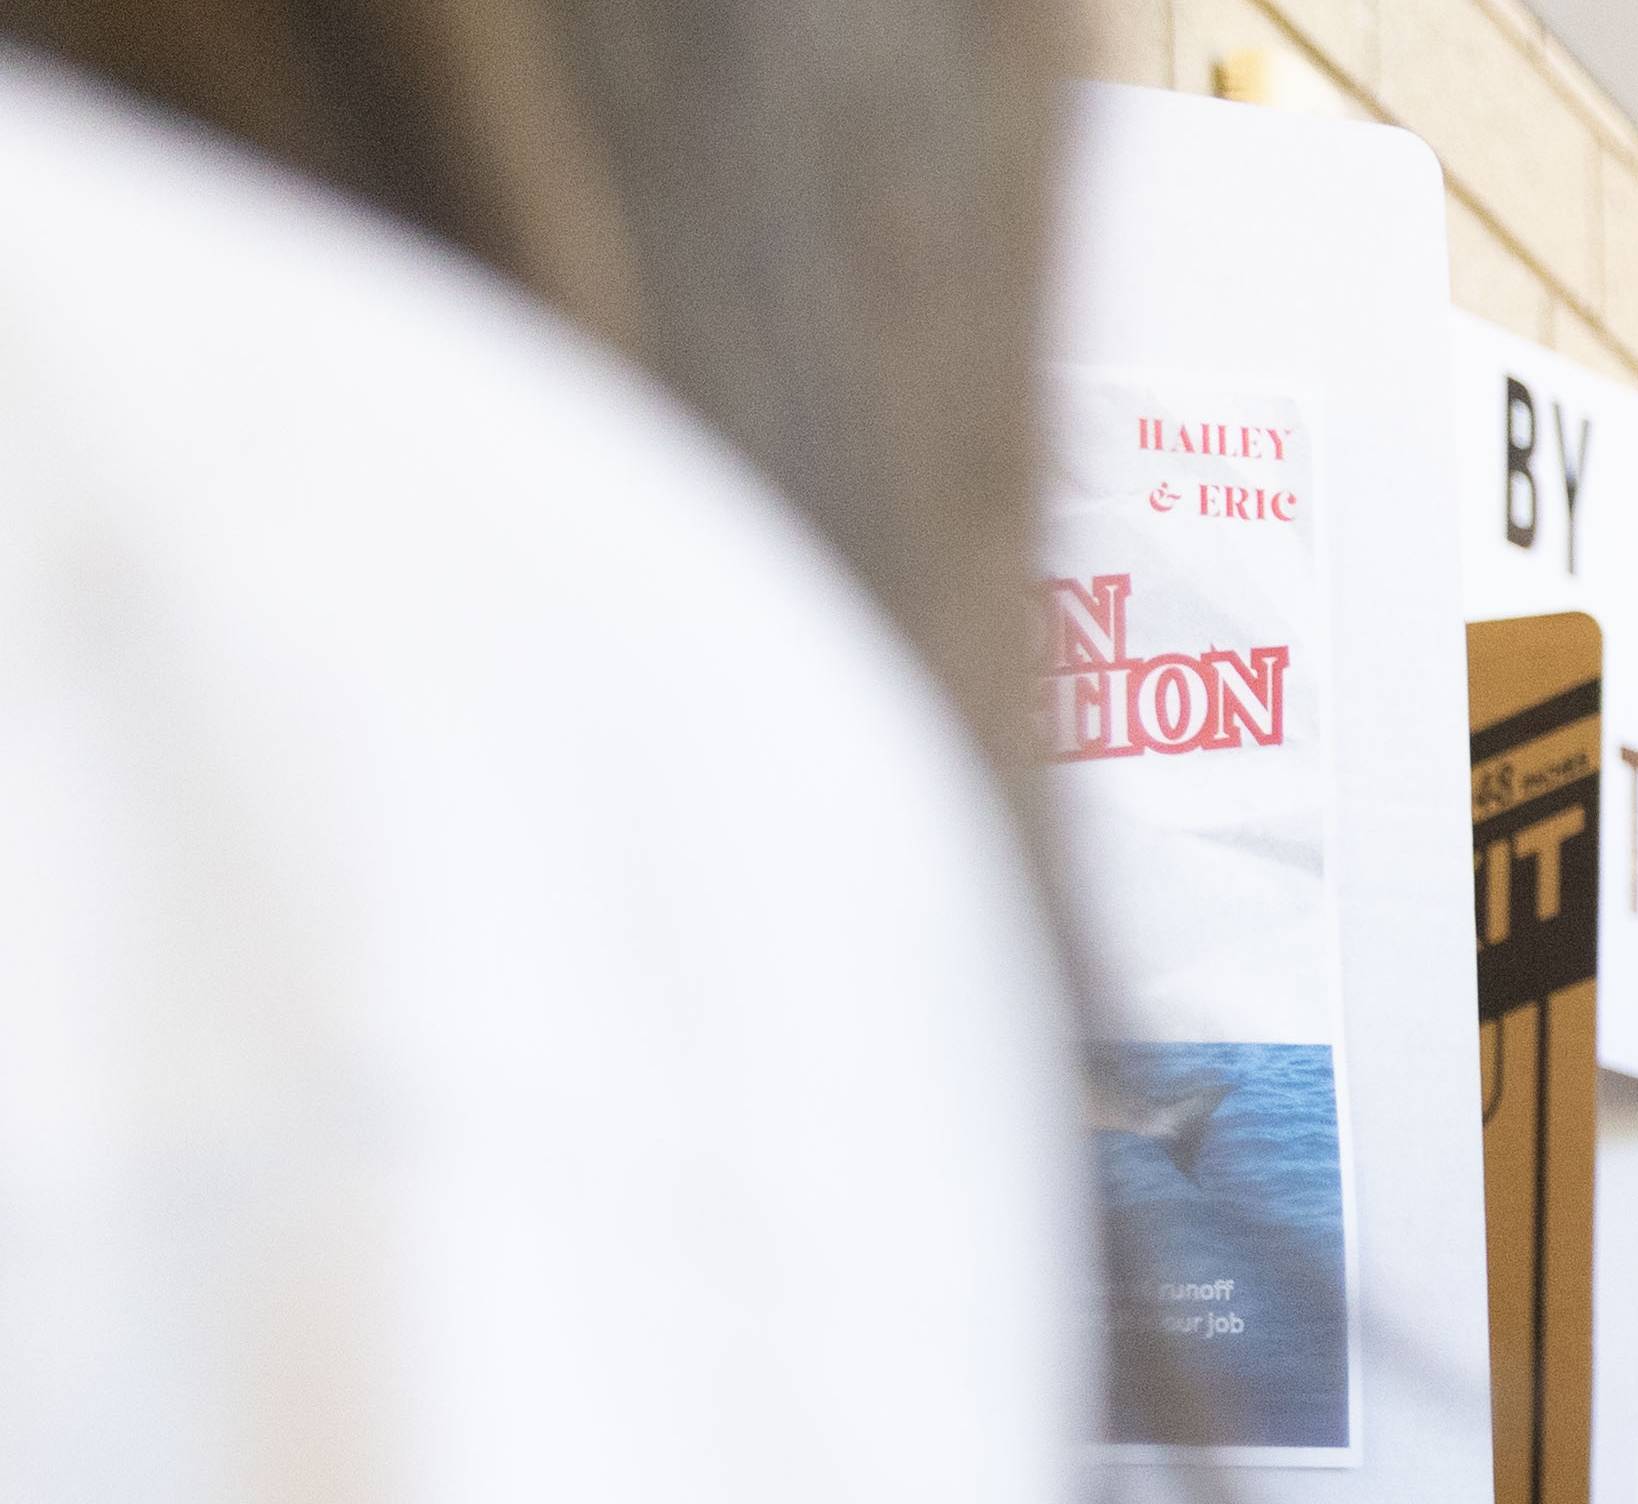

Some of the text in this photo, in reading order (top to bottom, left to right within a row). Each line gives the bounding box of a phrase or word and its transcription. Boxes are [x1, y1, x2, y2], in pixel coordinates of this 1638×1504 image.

[1138, 416, 1293, 462] HAILEY
[1506, 376, 1590, 575] BY
[1149, 480, 1298, 522] & ERIC
[1042, 573, 1133, 663] N
[1042, 642, 1291, 758] TION
[1474, 804, 1586, 946] IT
[1205, 1311, 1245, 1338] job
